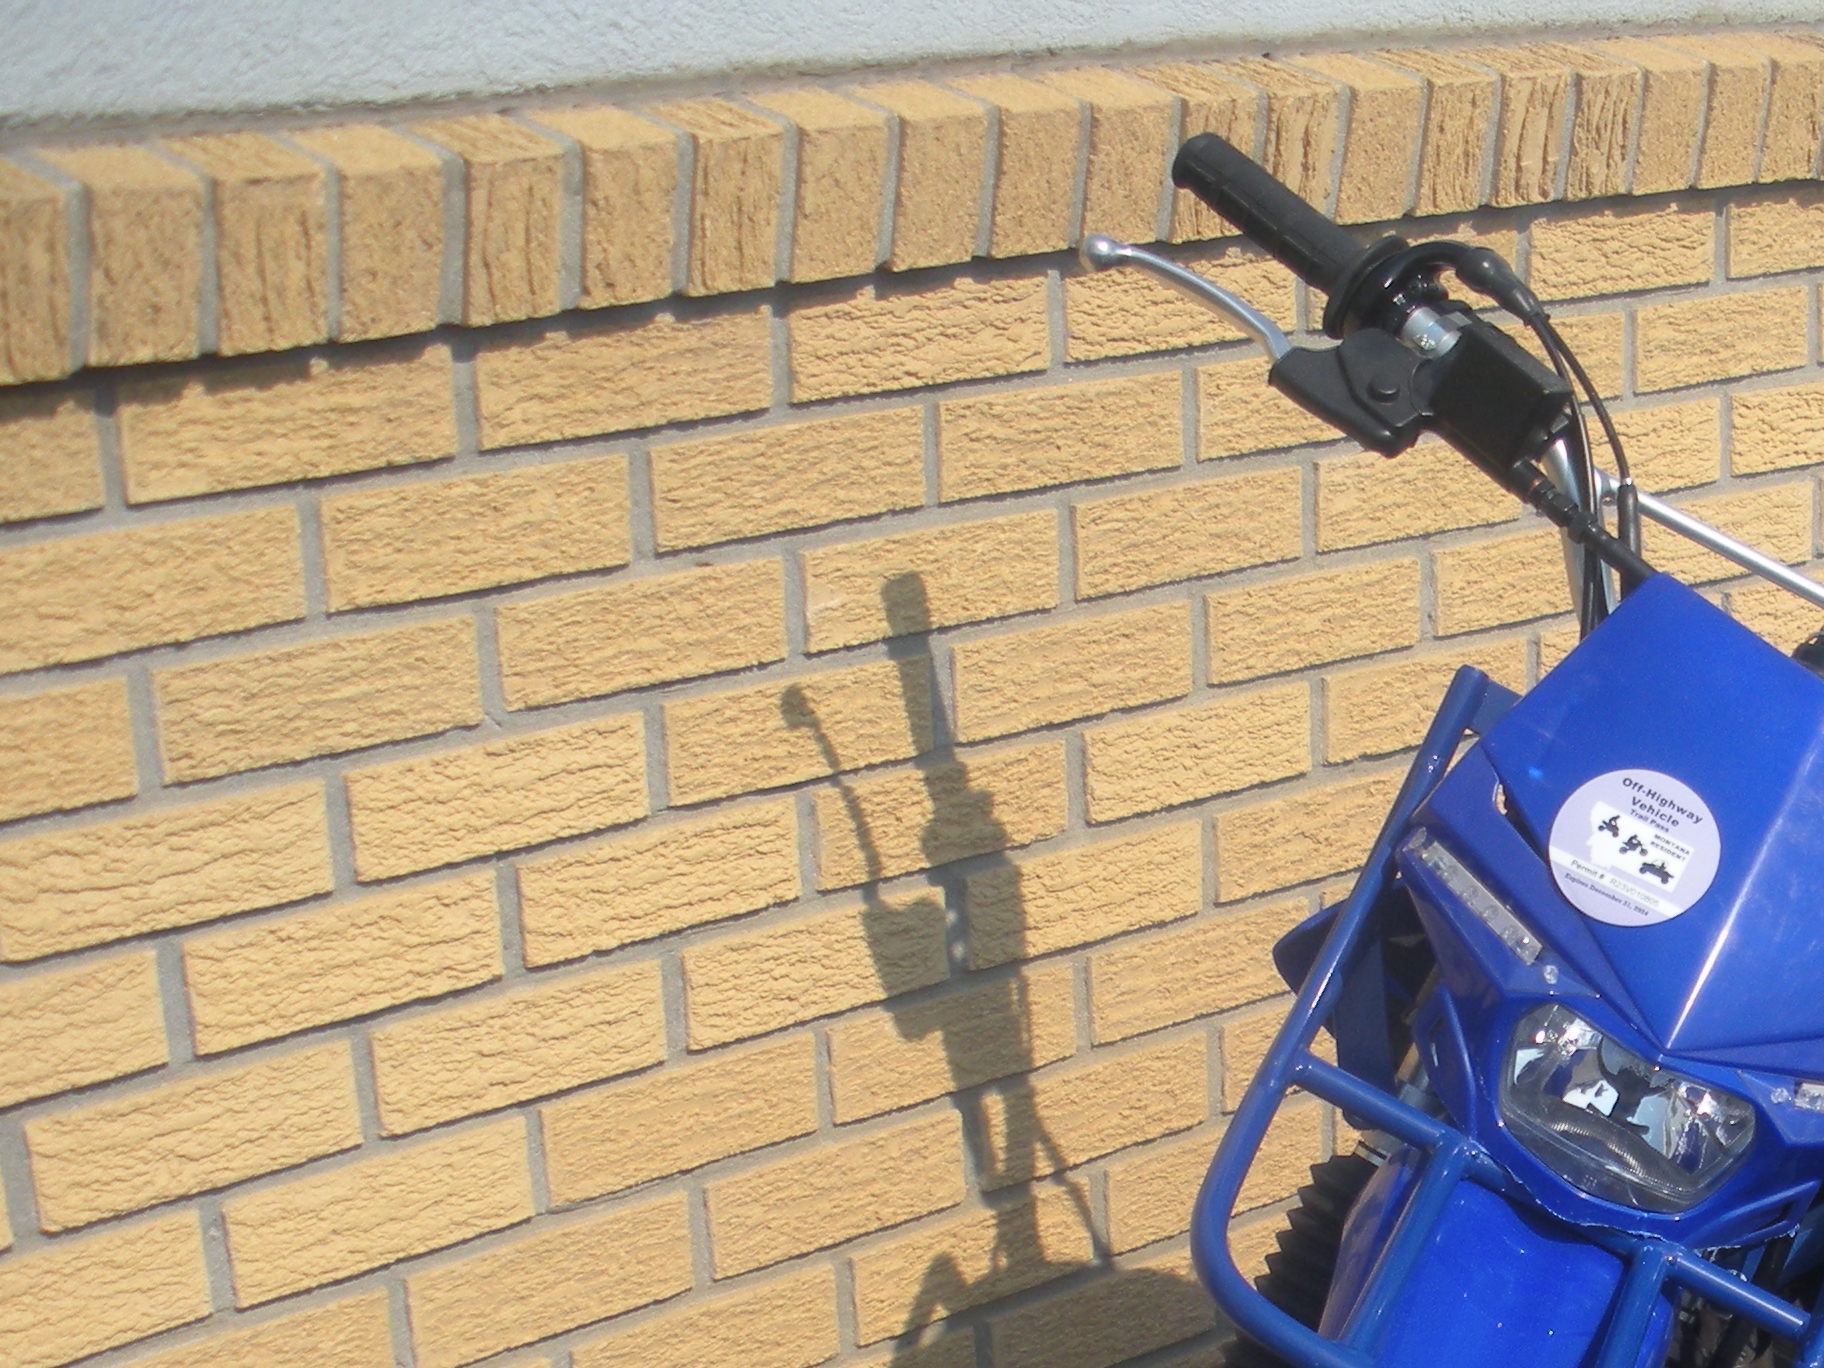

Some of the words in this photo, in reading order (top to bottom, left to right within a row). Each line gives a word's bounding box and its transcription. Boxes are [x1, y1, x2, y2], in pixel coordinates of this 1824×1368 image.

[1622, 778, 1703, 824] Off-Highway
[1632, 796, 1679, 827] Vehicle
[1630, 808, 1649, 822] Trail
[1650, 819, 1669, 832] Pass
[1650, 841, 1686, 861] RESIDENT
[1654, 834, 1690, 855] MONTANA
[1571, 859, 1598, 877] Permit
[1564, 872, 1589, 888] Expires
[1589, 883, 1622, 904] December
